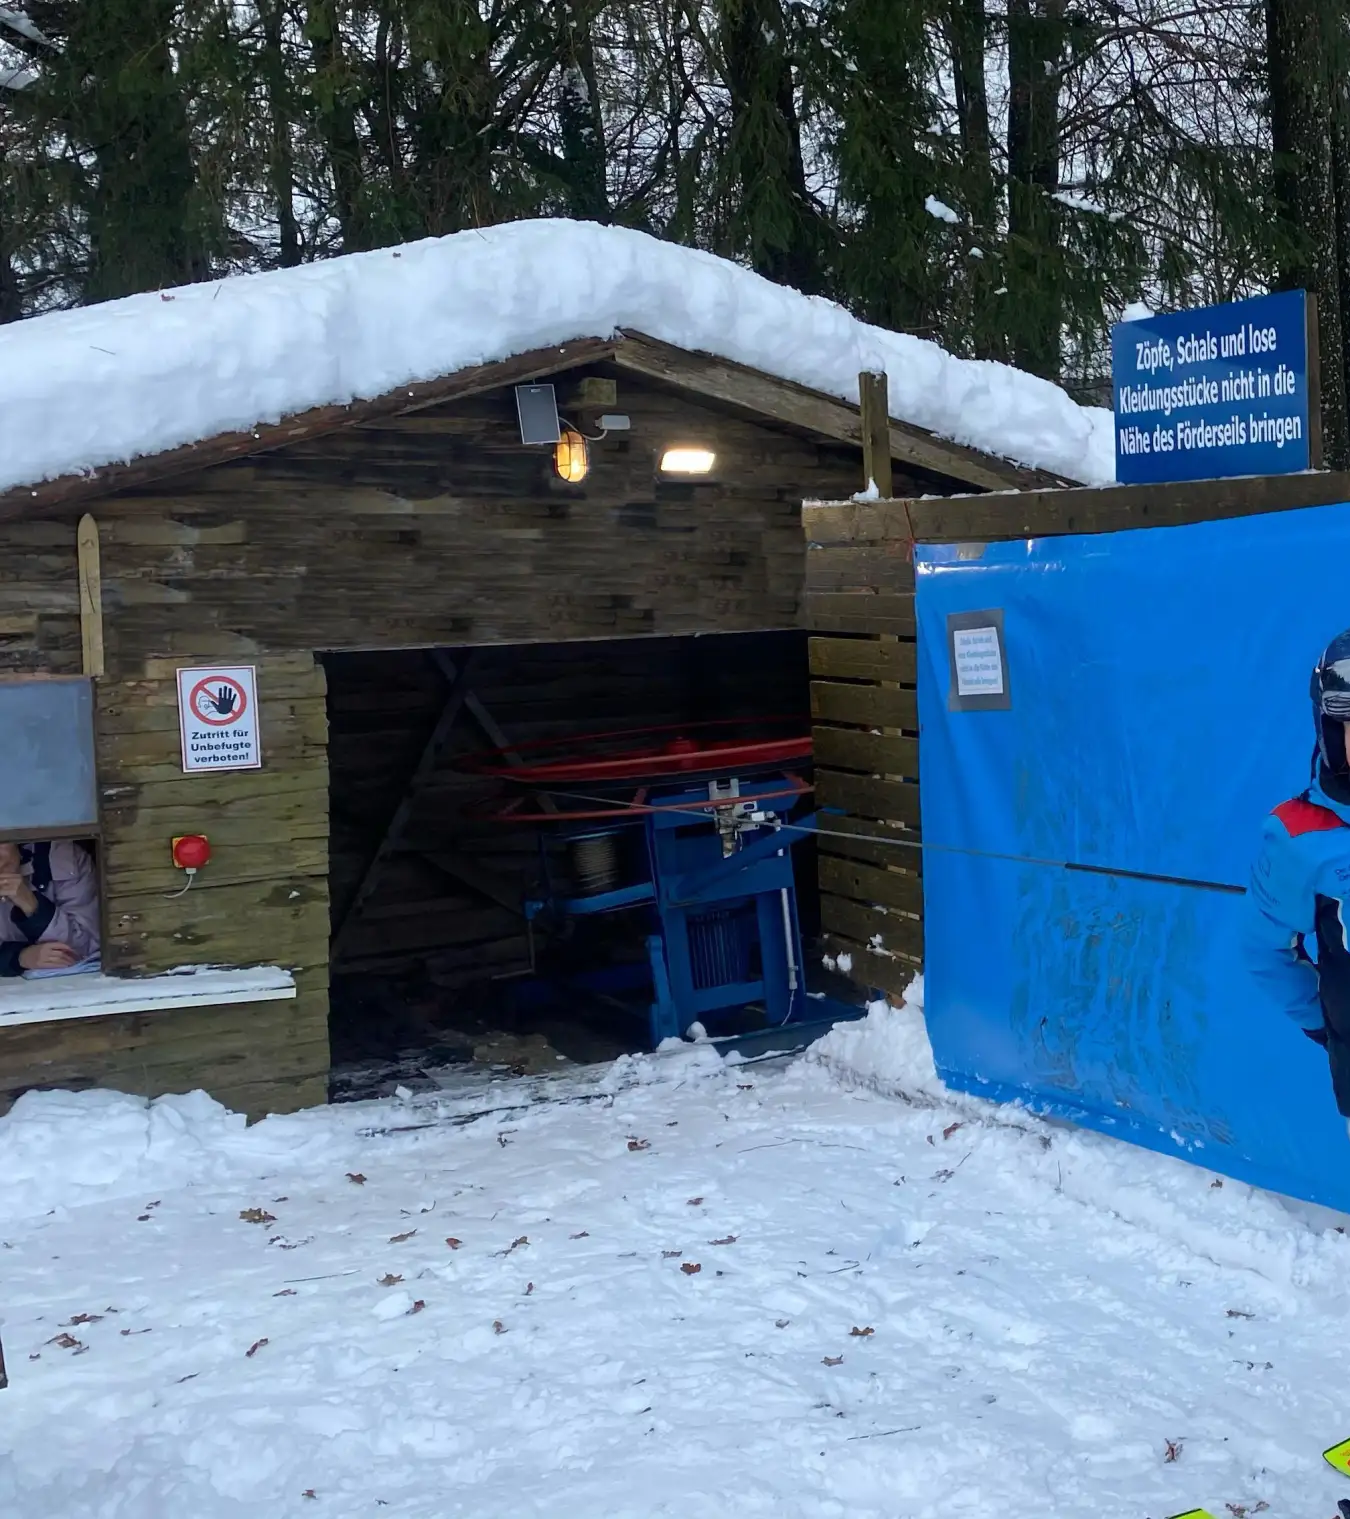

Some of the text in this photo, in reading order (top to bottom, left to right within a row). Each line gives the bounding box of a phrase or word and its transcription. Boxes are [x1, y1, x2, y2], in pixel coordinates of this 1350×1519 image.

[1136, 323, 1277, 374] Zöpfe, Schals und lose
[1120, 364, 1296, 416] Kleidungsstücke nicht in die
[1120, 412, 1302, 455] Nähe des Förderseils bringen
[191, 741, 252, 752] Unbefugte
[192, 729, 249, 739] Zutritt für
[194, 752, 249, 763] verboten!
